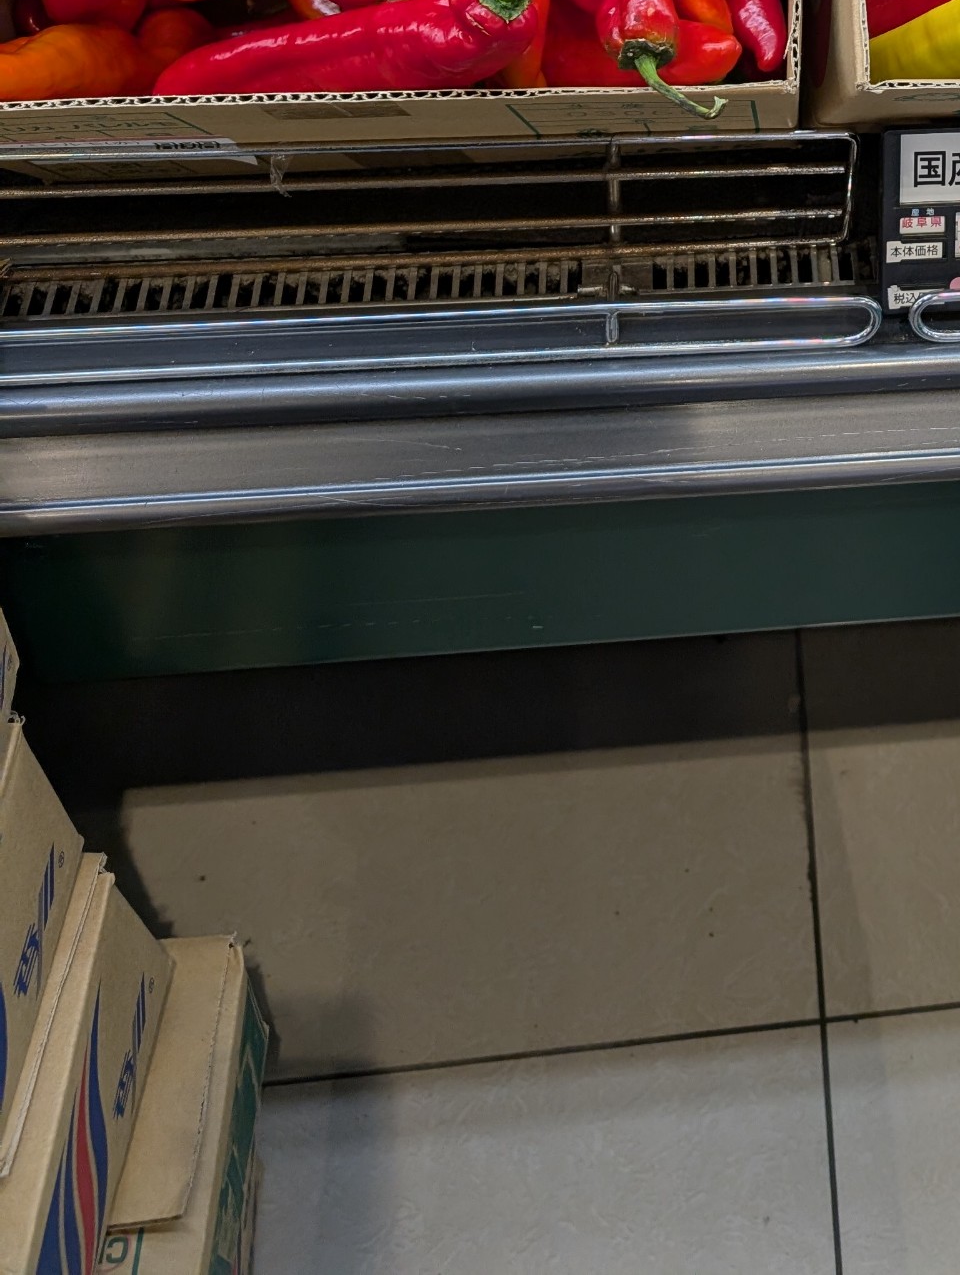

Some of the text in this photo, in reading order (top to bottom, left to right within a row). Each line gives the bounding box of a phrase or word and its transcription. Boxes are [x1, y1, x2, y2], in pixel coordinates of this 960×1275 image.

[902, 215, 941, 229] 岐阜県
[890, 244, 939, 258] 本体価格
